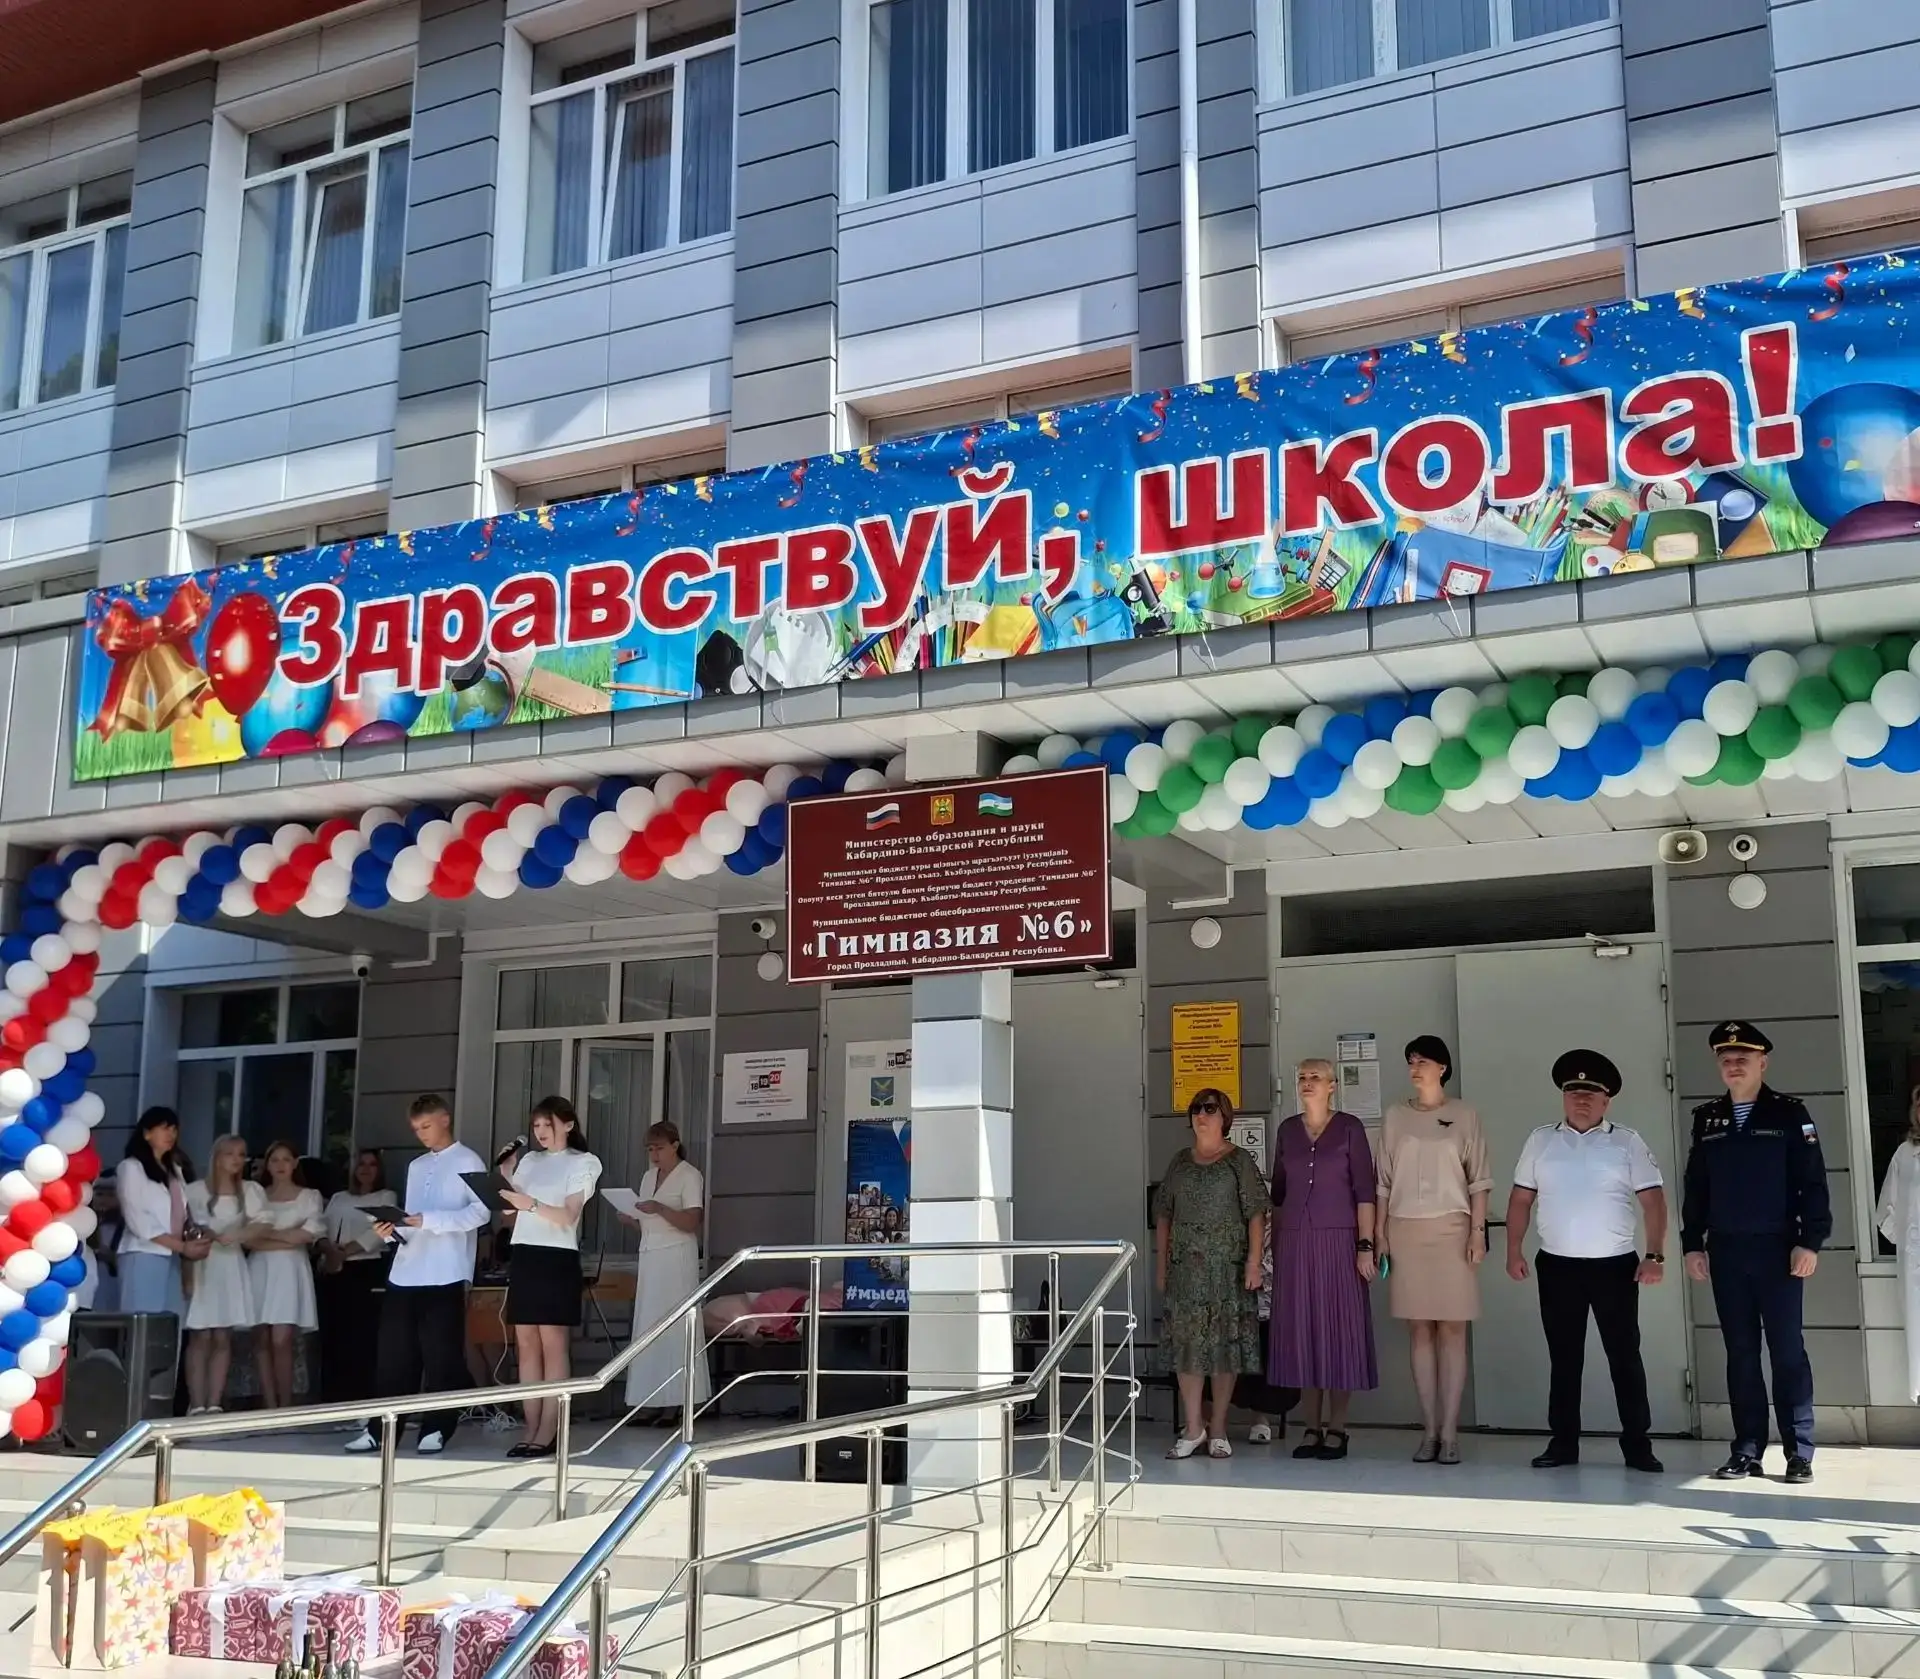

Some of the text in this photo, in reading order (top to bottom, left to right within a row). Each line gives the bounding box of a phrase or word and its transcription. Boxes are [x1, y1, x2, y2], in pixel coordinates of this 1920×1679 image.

[276, 322, 1803, 698] Здравствуй, школа!
[845, 835, 922, 849] Министерство
[925, 827, 996, 843] образования
[1011, 822, 1044, 834] науки
[846, 834, 1044, 861] Кабардино-Балкарской Республики
[812, 898, 1081, 928] Муниципальное бюджетное общеобразовательное учреждение
[802, 910, 1092, 959] «Гимназия №6»
[827, 961, 852, 972] Город
[911, 948, 1010, 966] Кабардино-Балкарская
[751, 1083, 759, 1091] 18
[769, 1073, 780, 1082] 20
